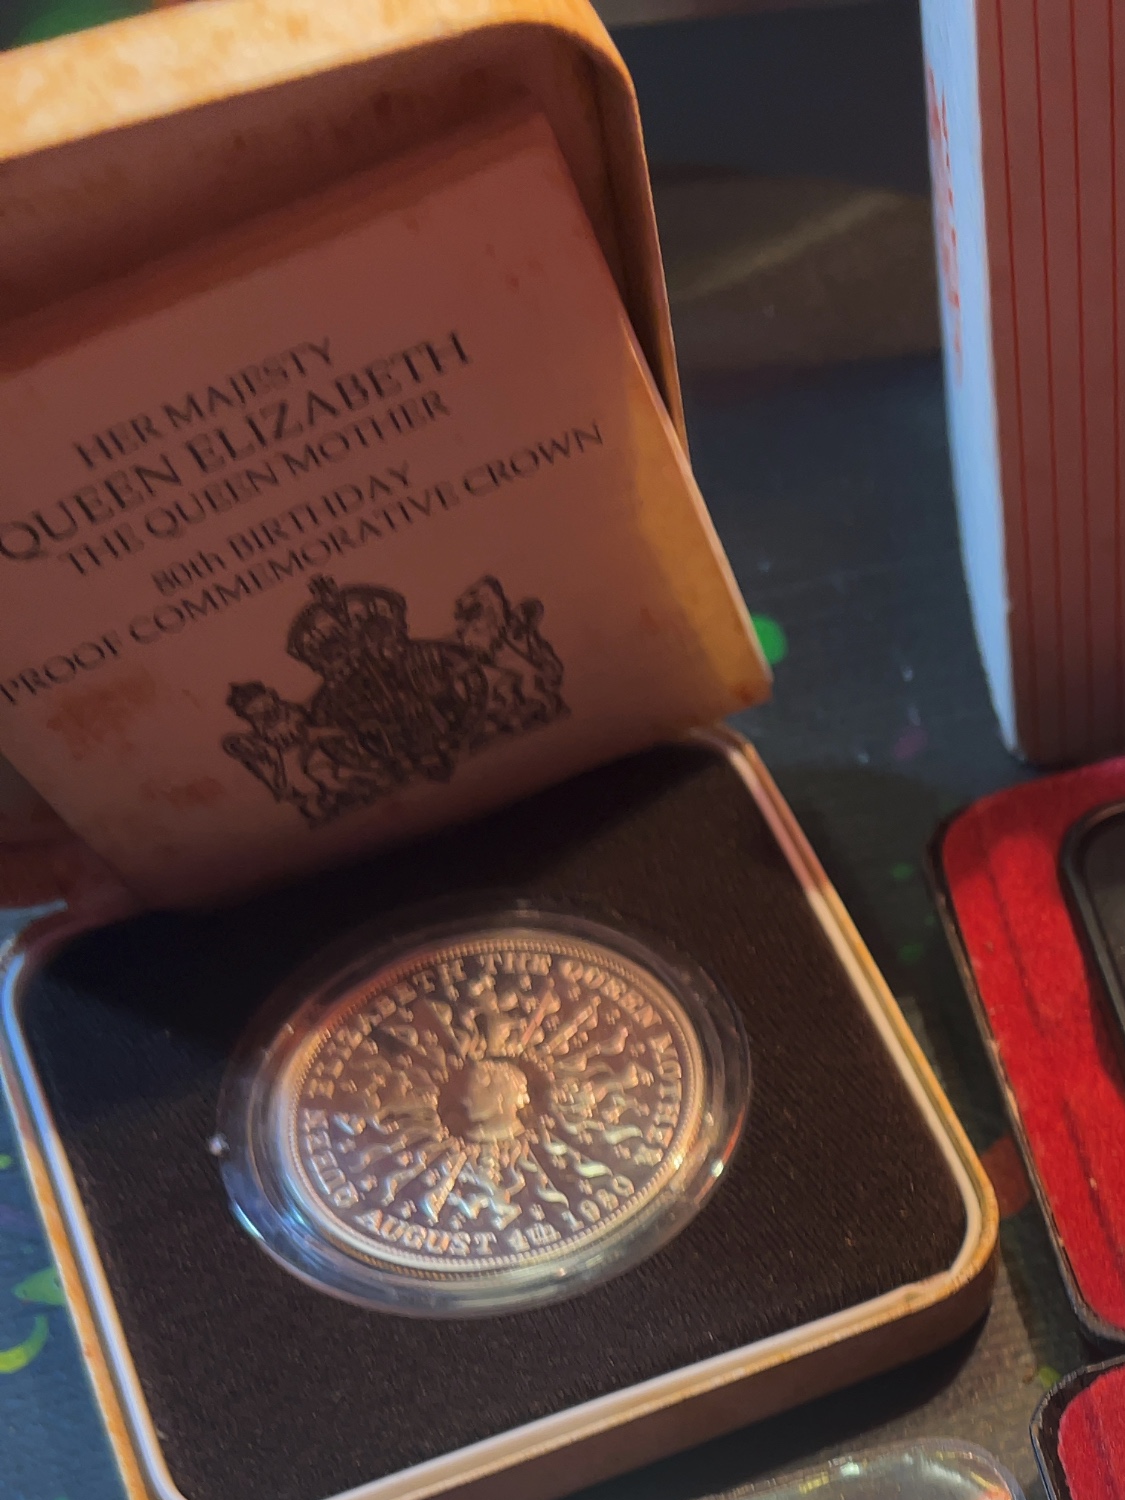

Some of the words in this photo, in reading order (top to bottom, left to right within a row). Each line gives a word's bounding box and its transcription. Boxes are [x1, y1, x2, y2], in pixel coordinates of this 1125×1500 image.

[0, 453, 182, 561] QUEEN
[186, 330, 470, 475] ELIZABETH
[58, 522, 145, 577] THE
[145, 461, 280, 540] QUEEN
[281, 390, 450, 477] MOTHER
[74, 412, 161, 470] HER
[163, 337, 332, 429] MAJESTY
[0, 629, 122, 706] PROOF
[128, 481, 460, 645] COMMEMORATIVE
[462, 419, 604, 497] CROWN
[228, 460, 411, 562] BIRTHDAY
[353, 1208, 498, 1257] AUGUST
